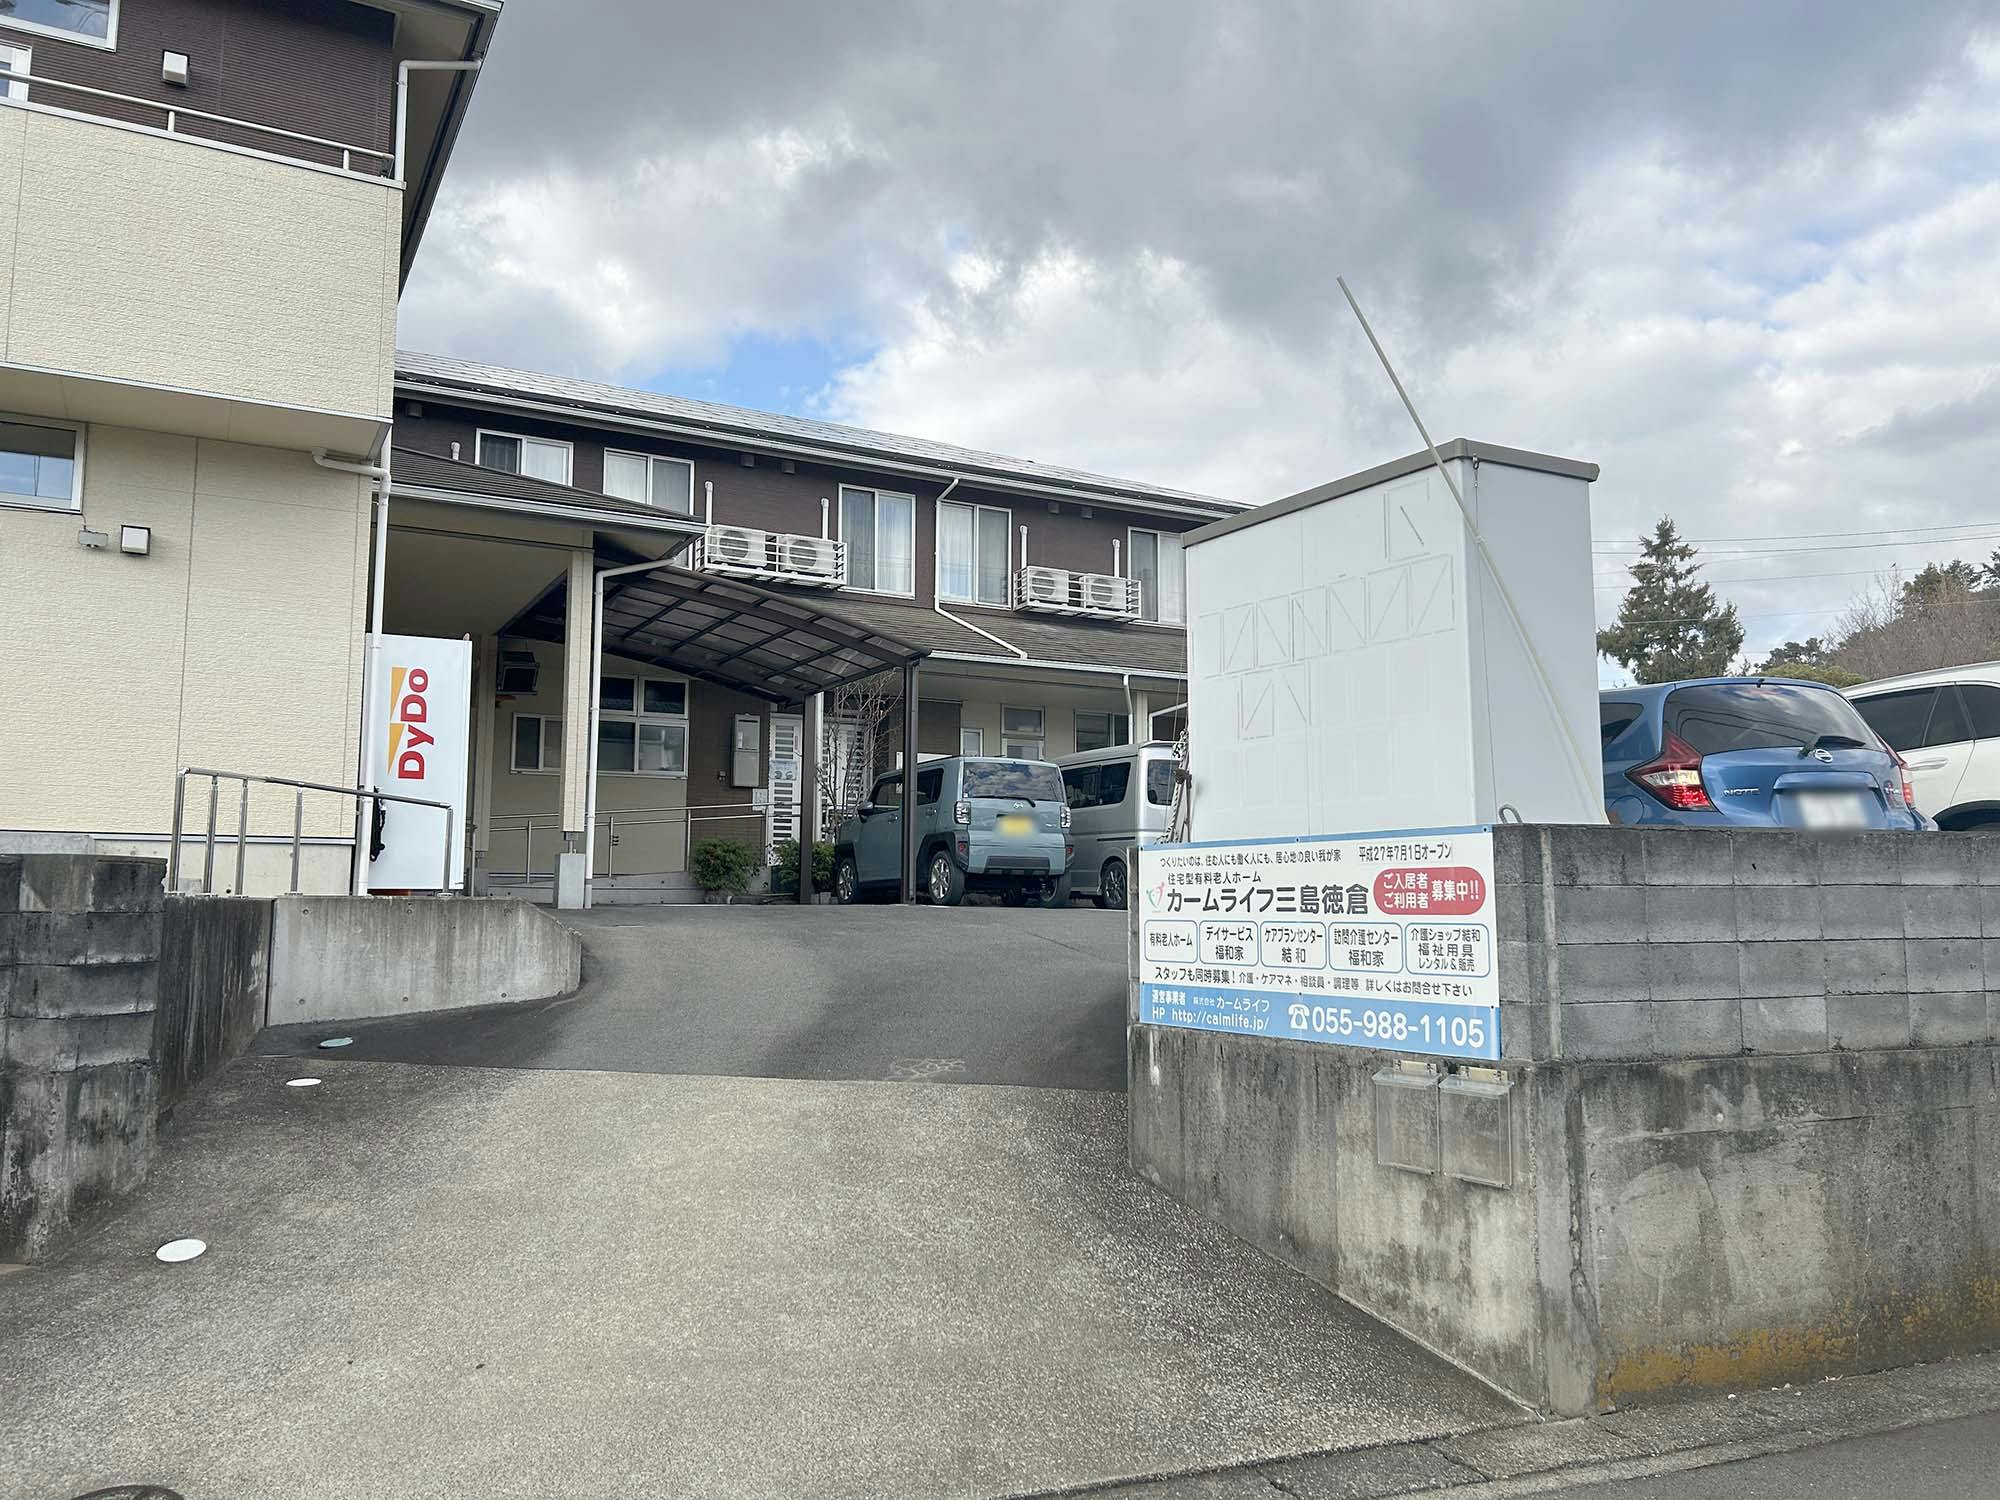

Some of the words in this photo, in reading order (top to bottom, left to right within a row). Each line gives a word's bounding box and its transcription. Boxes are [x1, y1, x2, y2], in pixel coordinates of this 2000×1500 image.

[398, 668, 434, 780] DyDo
[1358, 841, 1452, 862] 平成27年7月1日オープン
[1167, 871, 1262, 886] 住宅型有料老人ホーム
[1383, 872, 1429, 890] ご入居者
[1166, 883, 1369, 915] カームライフ三島徳倉
[1431, 880, 1479, 901] 募集中!!
[1384, 892, 1429, 909] ご利用者
[1149, 932, 1193, 947] 有料老人ホーム
[1205, 926, 1254, 942] デイサービス
[1264, 928, 1323, 944] ケアプランセンター
[1334, 928, 1399, 946] 訪問介護センター
[1410, 928, 1481, 942] 介護ショップ結和
[1215, 945, 1244, 961] 福和家
[1348, 949, 1384, 967] 福和家
[1152, 1006, 1166, 1020] HP
[1172, 1008, 1270, 1031] http://calmlife.jp/
[1312, 1005, 1485, 1048] 055-988-1105
